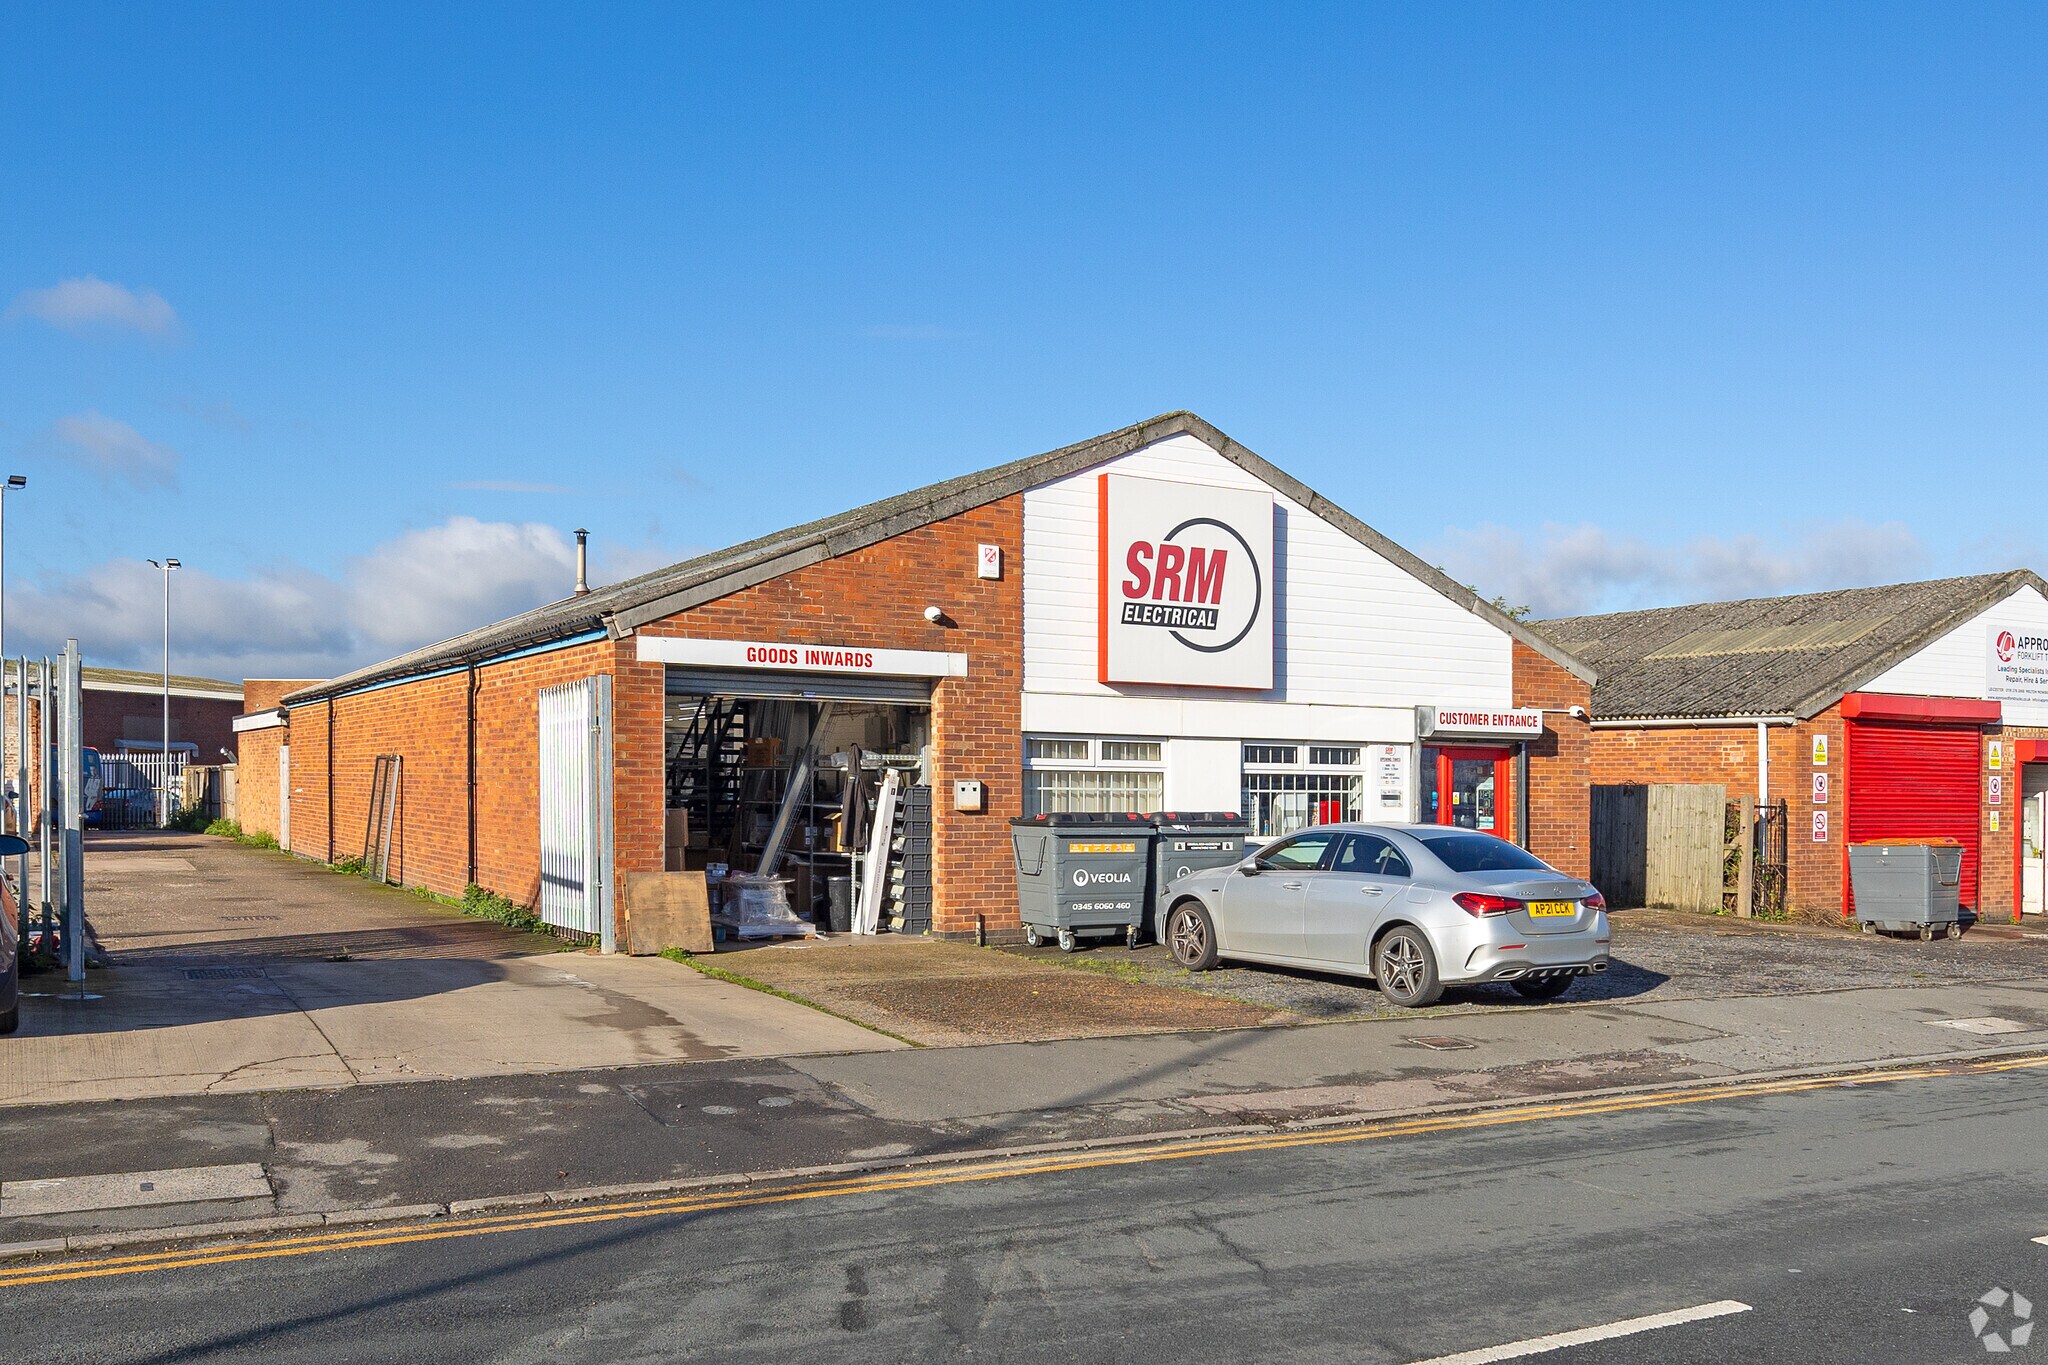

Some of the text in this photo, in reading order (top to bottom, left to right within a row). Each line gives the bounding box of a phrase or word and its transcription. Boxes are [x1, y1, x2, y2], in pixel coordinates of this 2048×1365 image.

[1122, 541, 1228, 605] SRM
[1123, 605, 1216, 627] ELECTRICAL
[2018, 637, 2048, 651] APPRO
[747, 647, 873, 667] GOODS INWARDS
[2018, 651, 2043, 661] FORKLIFT
[1998, 665, 2017, 674] Leading
[2019, 666, 2044, 675] Specialists
[2006, 676, 2023, 684] Repair,
[1440, 712, 1538, 727] CUSTOMER ENTRANCE
[1090, 873, 1131, 883] VEOLIA
[1094, 902, 1114, 910] 6060
[1115, 902, 1131, 910] 460
[1535, 903, 1570, 914] AP21 CCK
